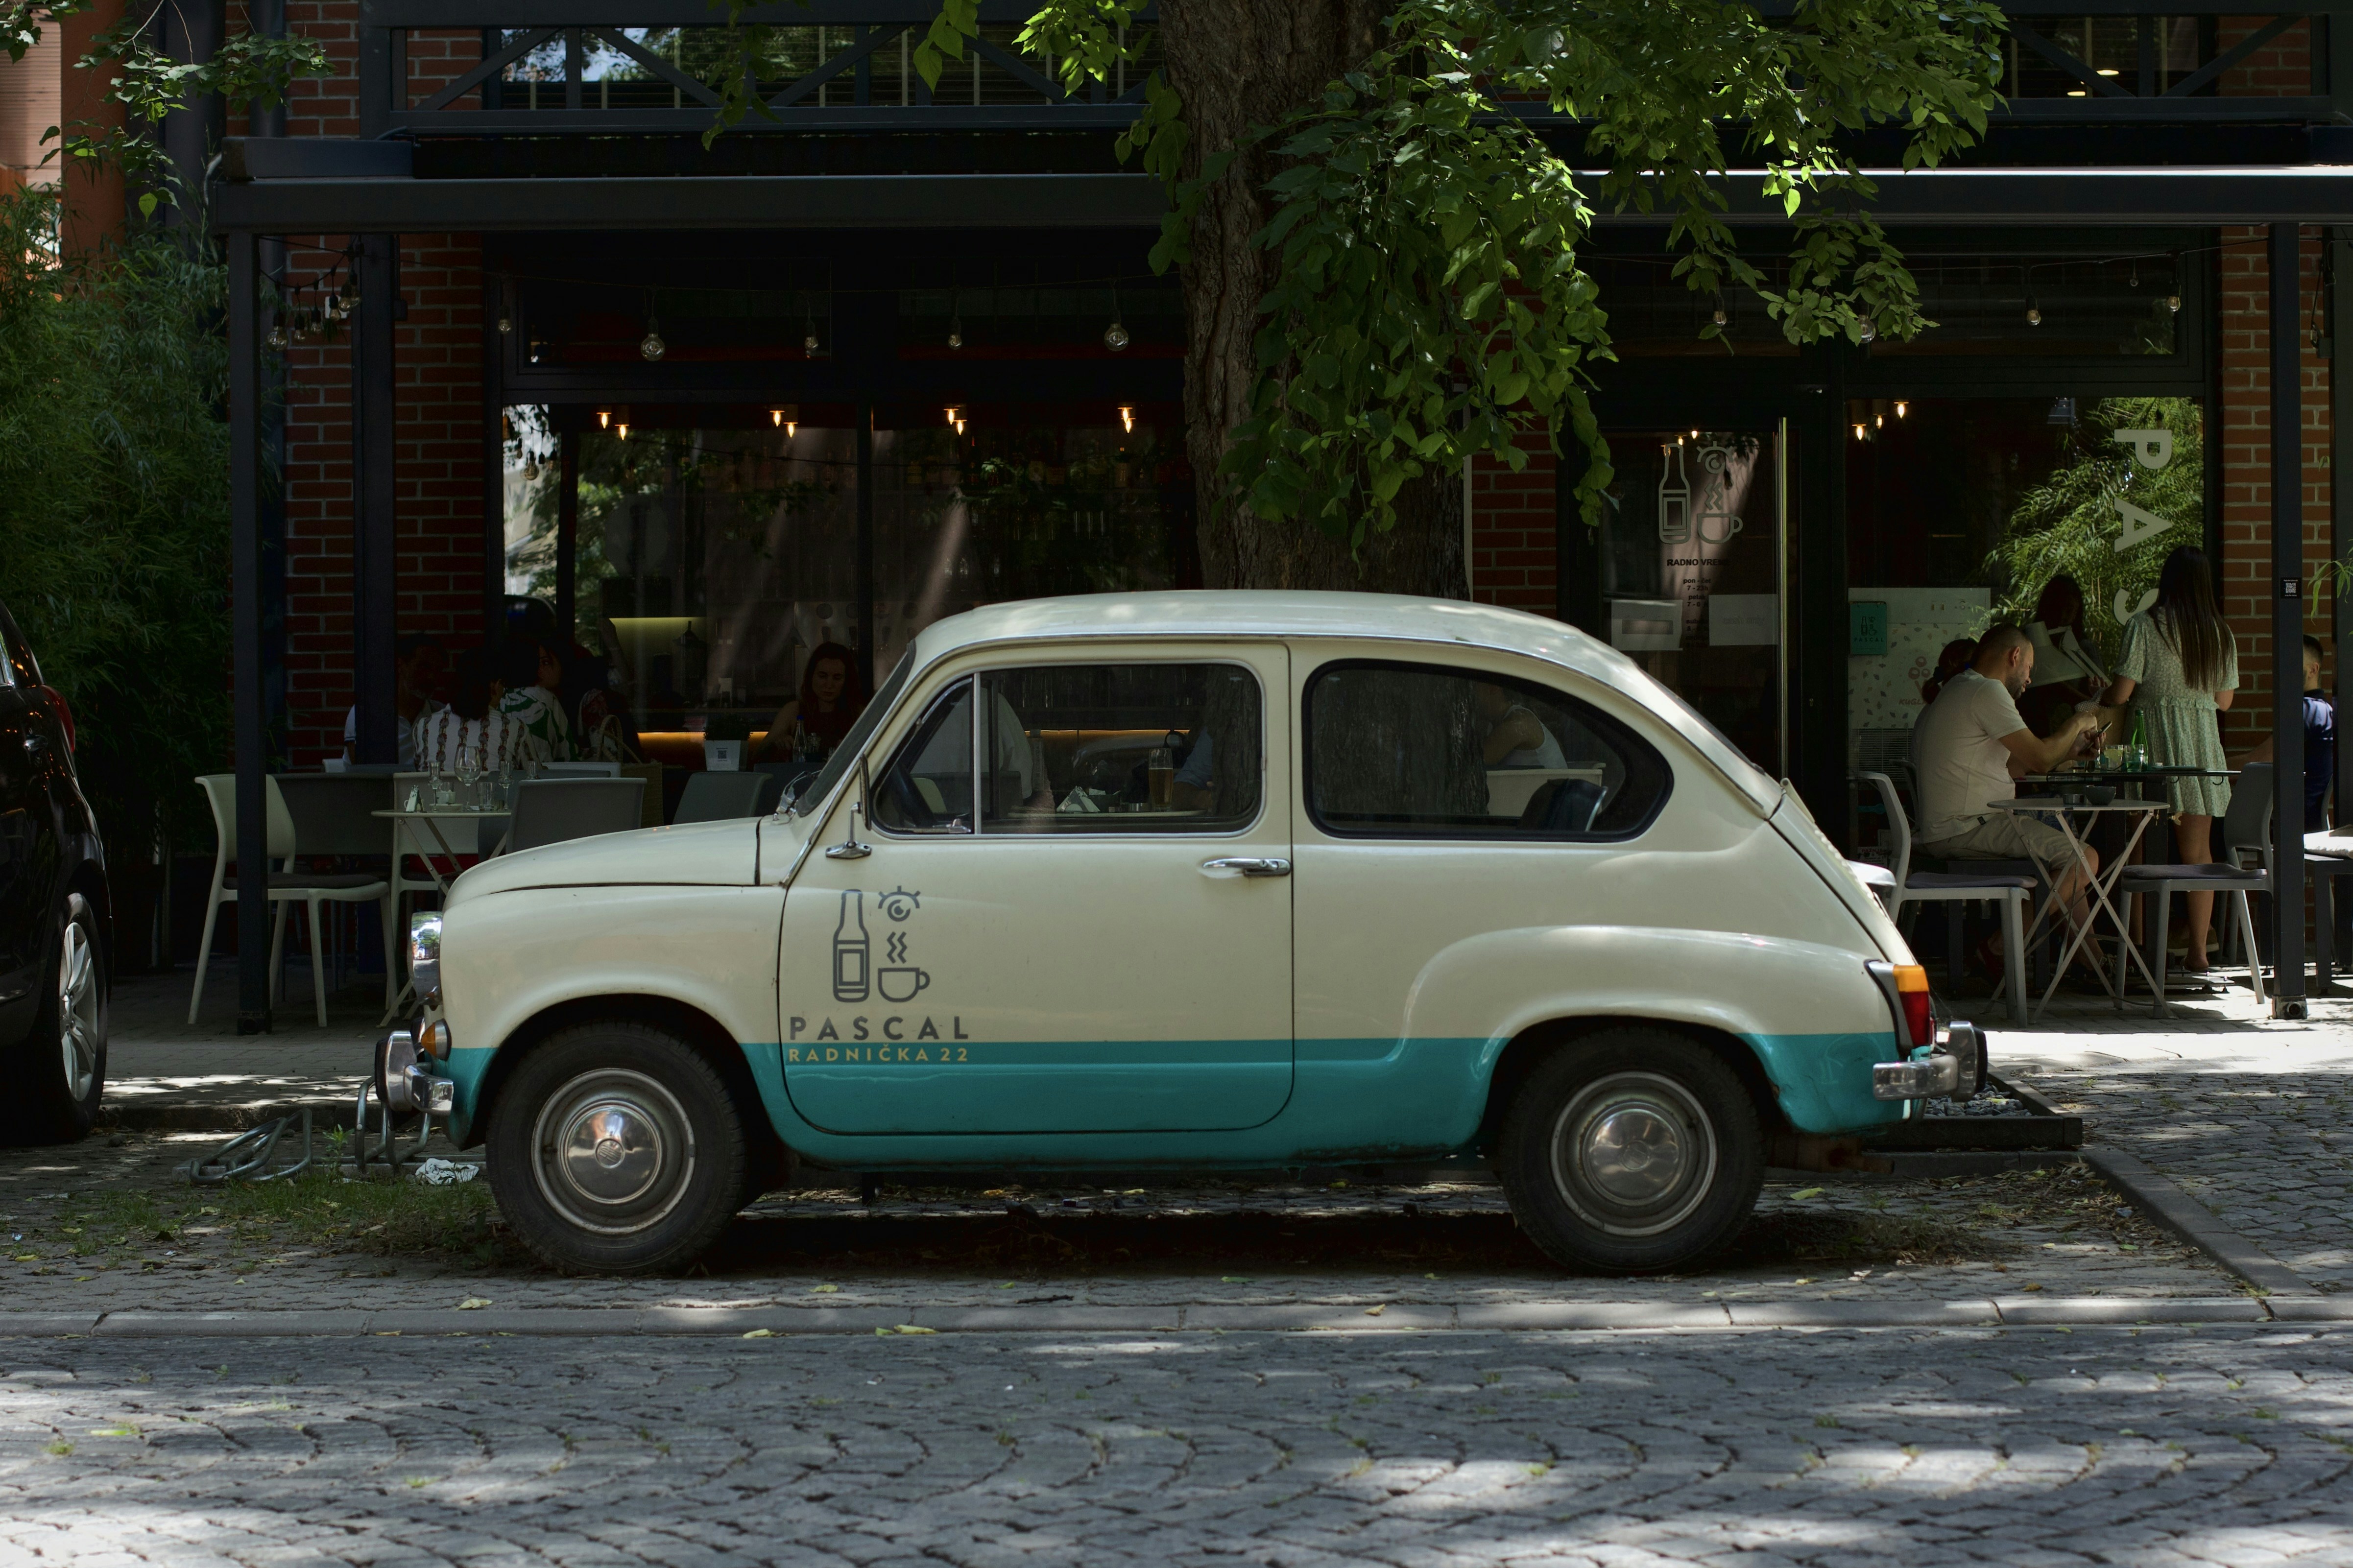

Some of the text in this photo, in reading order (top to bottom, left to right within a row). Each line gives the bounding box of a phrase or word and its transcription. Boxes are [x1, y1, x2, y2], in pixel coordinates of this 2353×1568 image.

[790, 1016, 968, 1040] PASCAL
[789, 1044, 968, 1062] RADNIČKA 22
